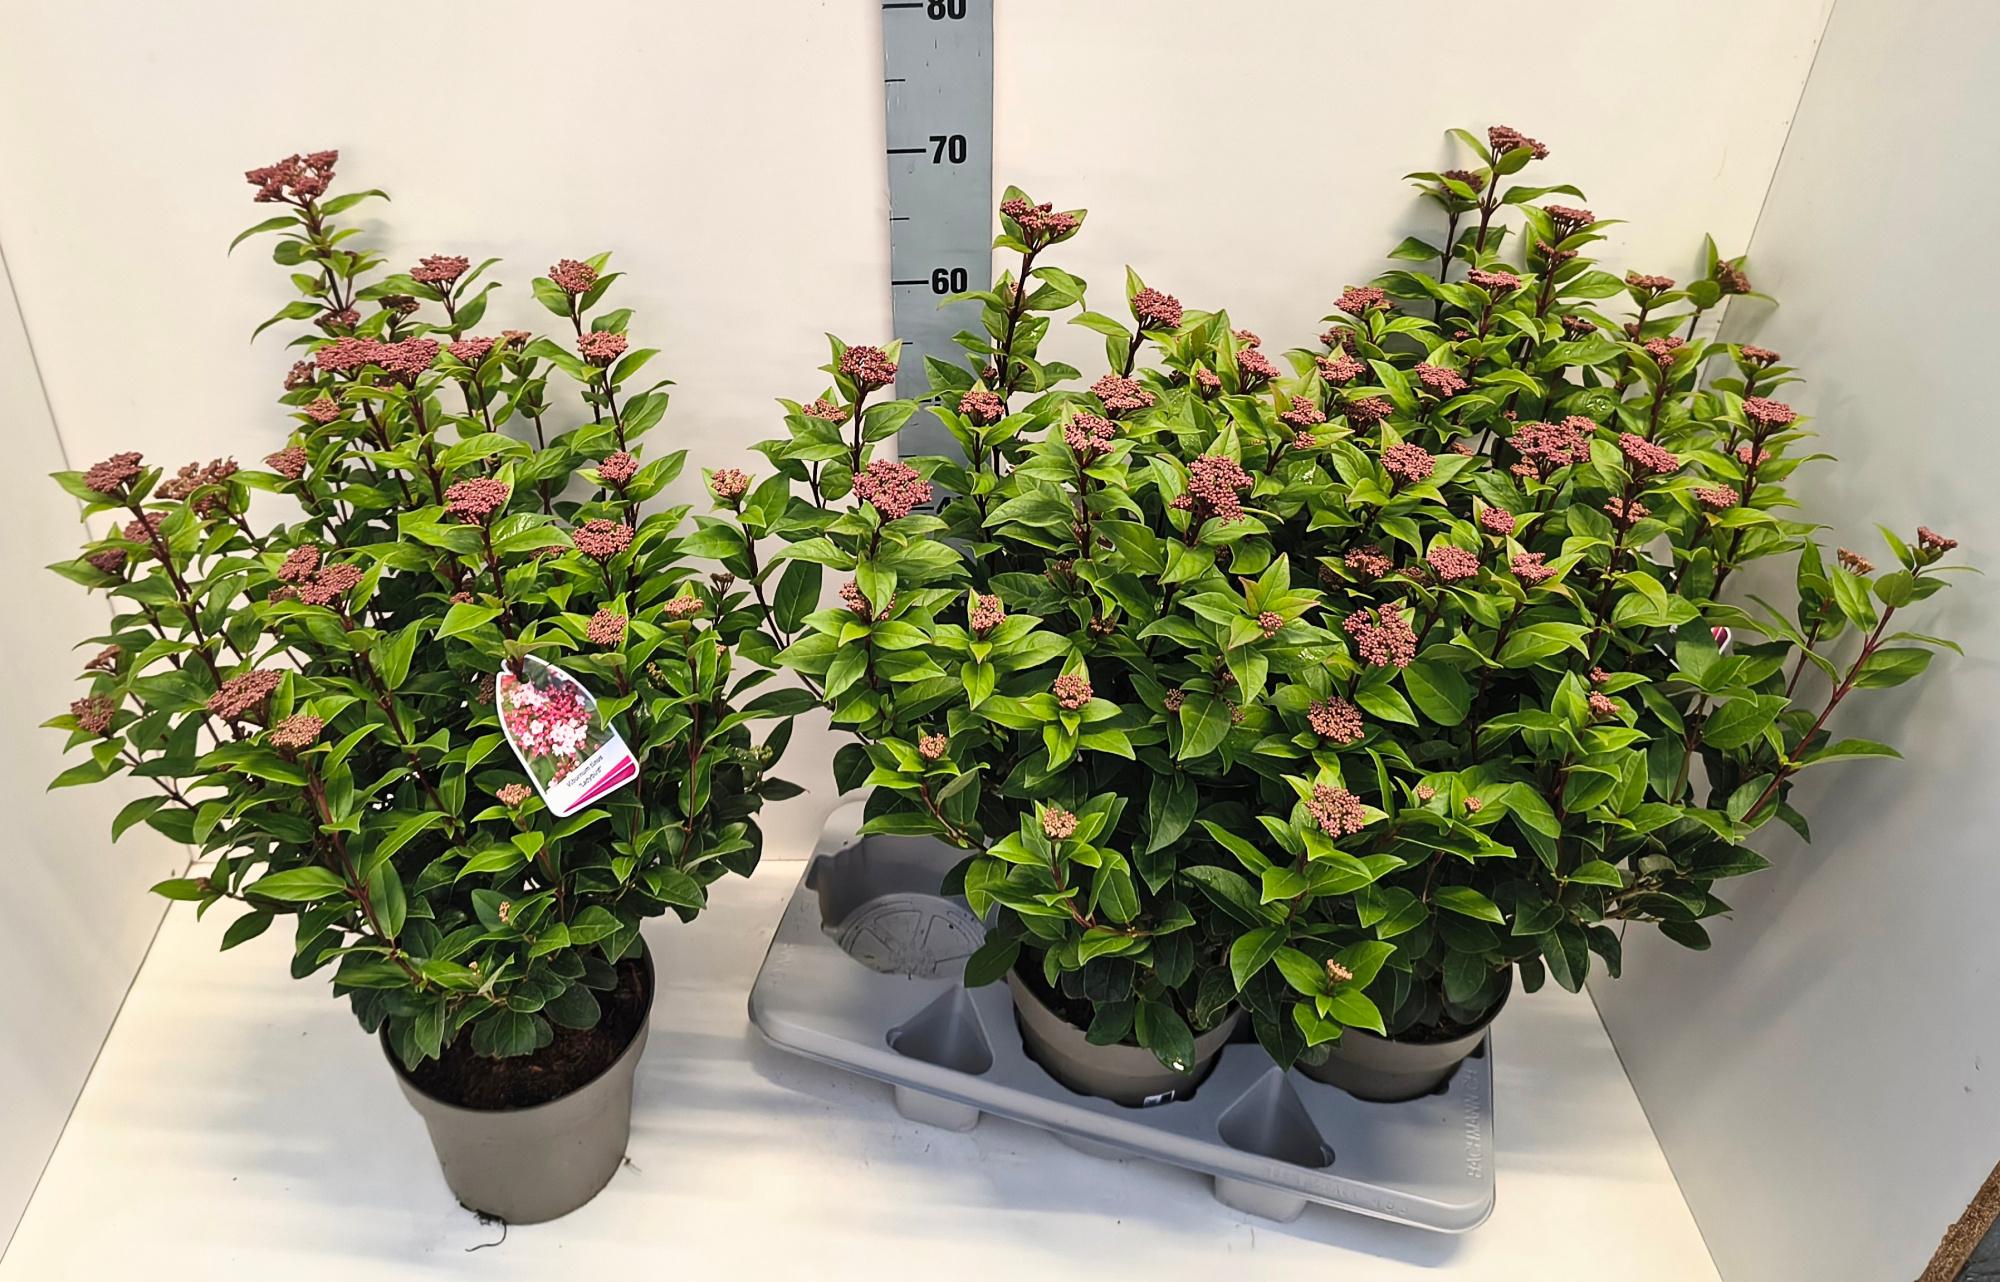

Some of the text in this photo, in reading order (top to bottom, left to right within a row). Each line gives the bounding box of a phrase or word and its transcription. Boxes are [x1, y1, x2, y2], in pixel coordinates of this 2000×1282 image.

[926, 0, 967, 20] 80
[929, 134, 967, 164] 70
[931, 267, 968, 295] 60
[1464, 1094, 1482, 1179] BACHMANN
